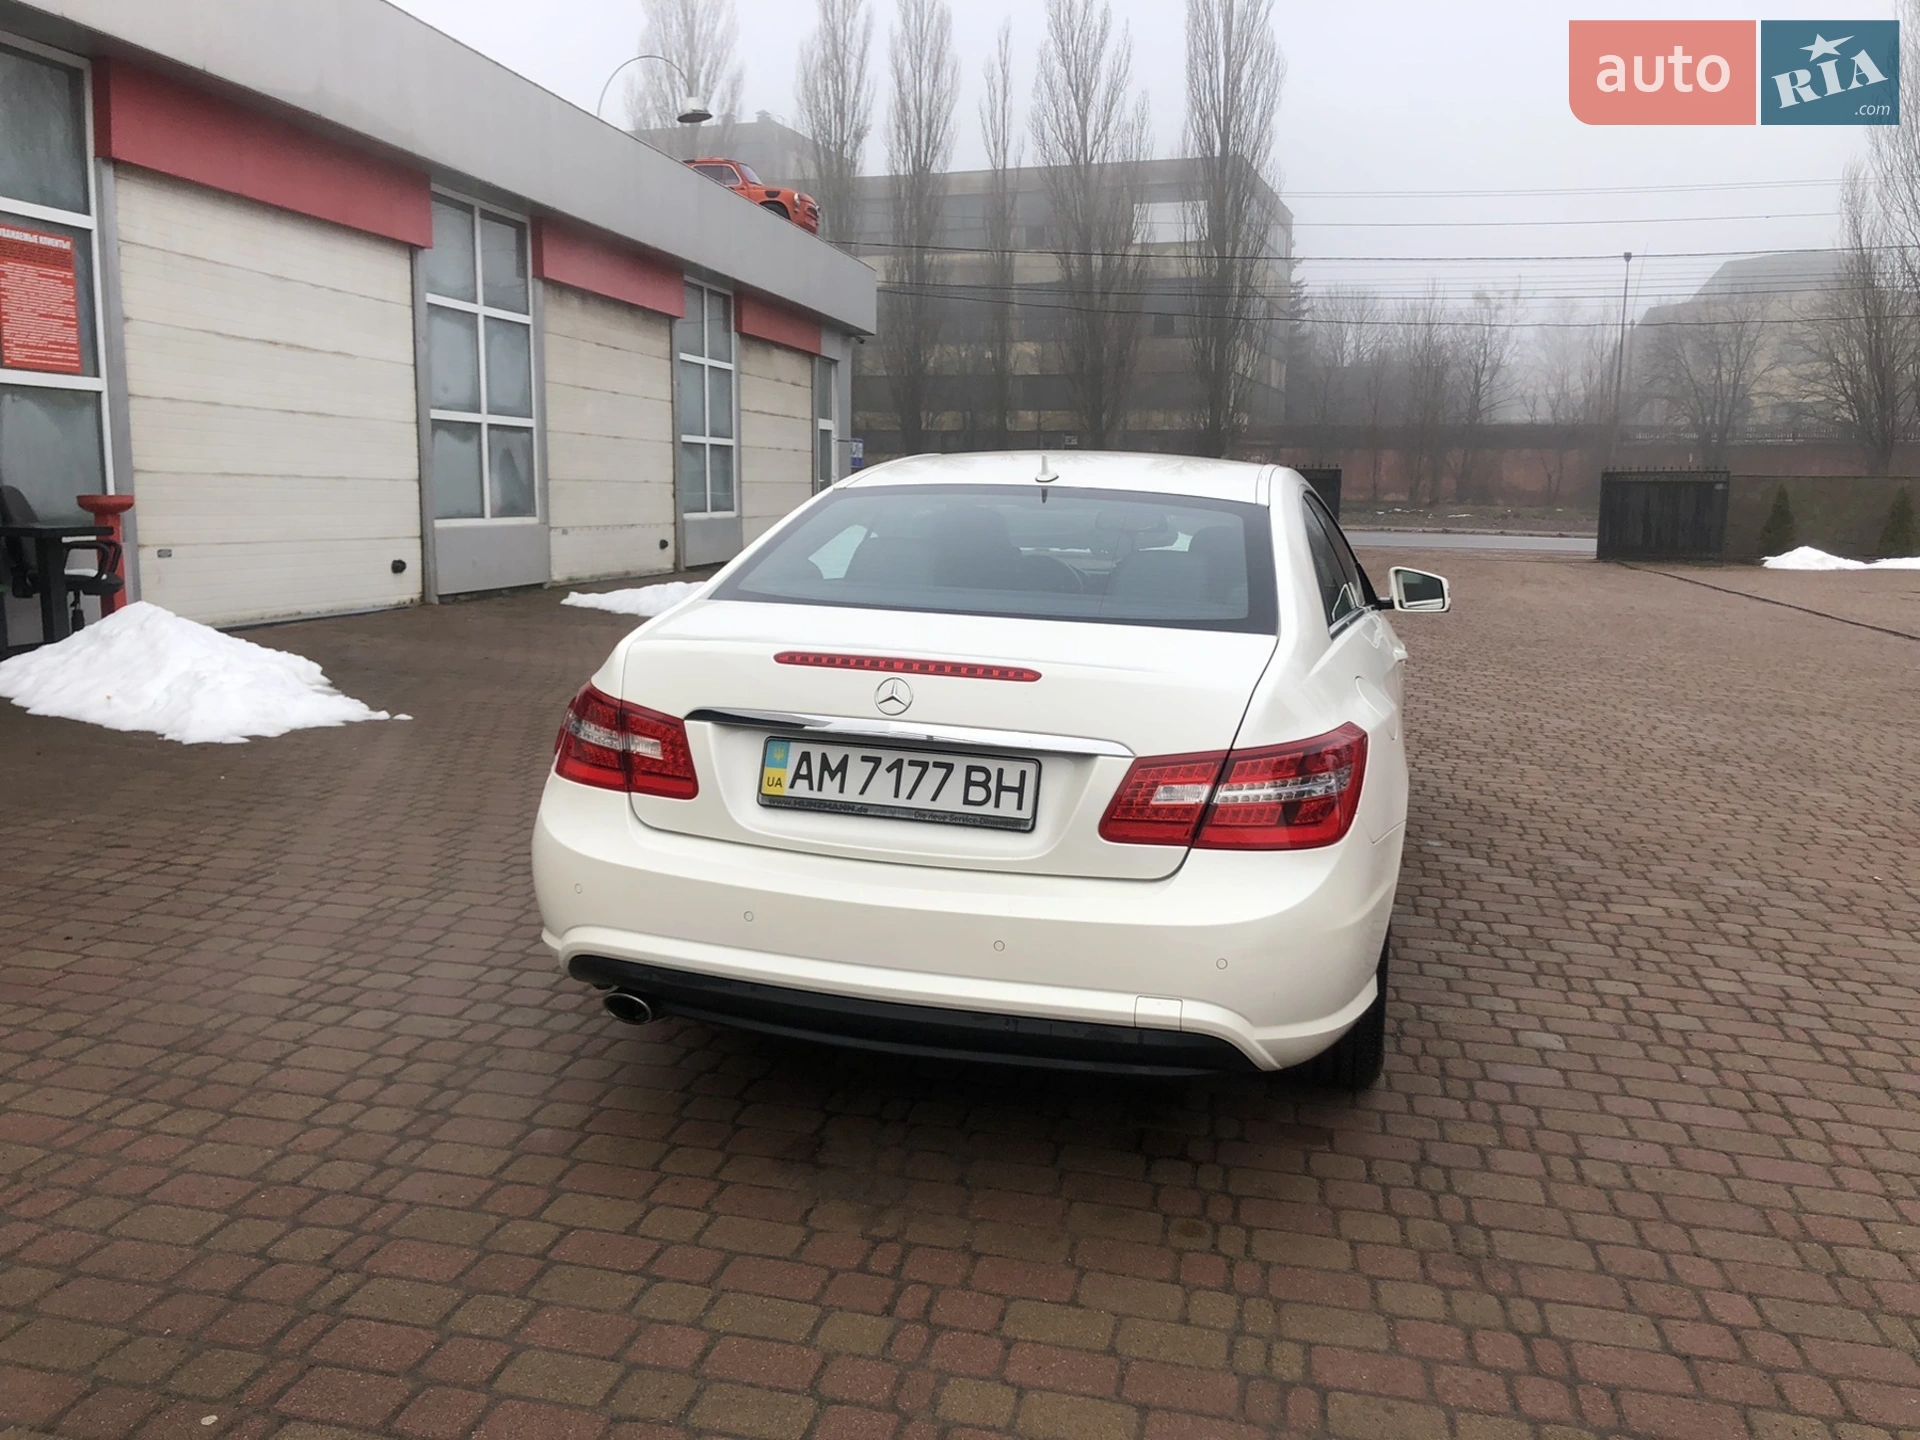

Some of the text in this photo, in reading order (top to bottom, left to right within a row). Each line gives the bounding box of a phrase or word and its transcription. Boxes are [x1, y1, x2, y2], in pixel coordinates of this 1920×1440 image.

[766, 776, 783, 788] UA
[788, 751, 1026, 811] AM 7177 BH
